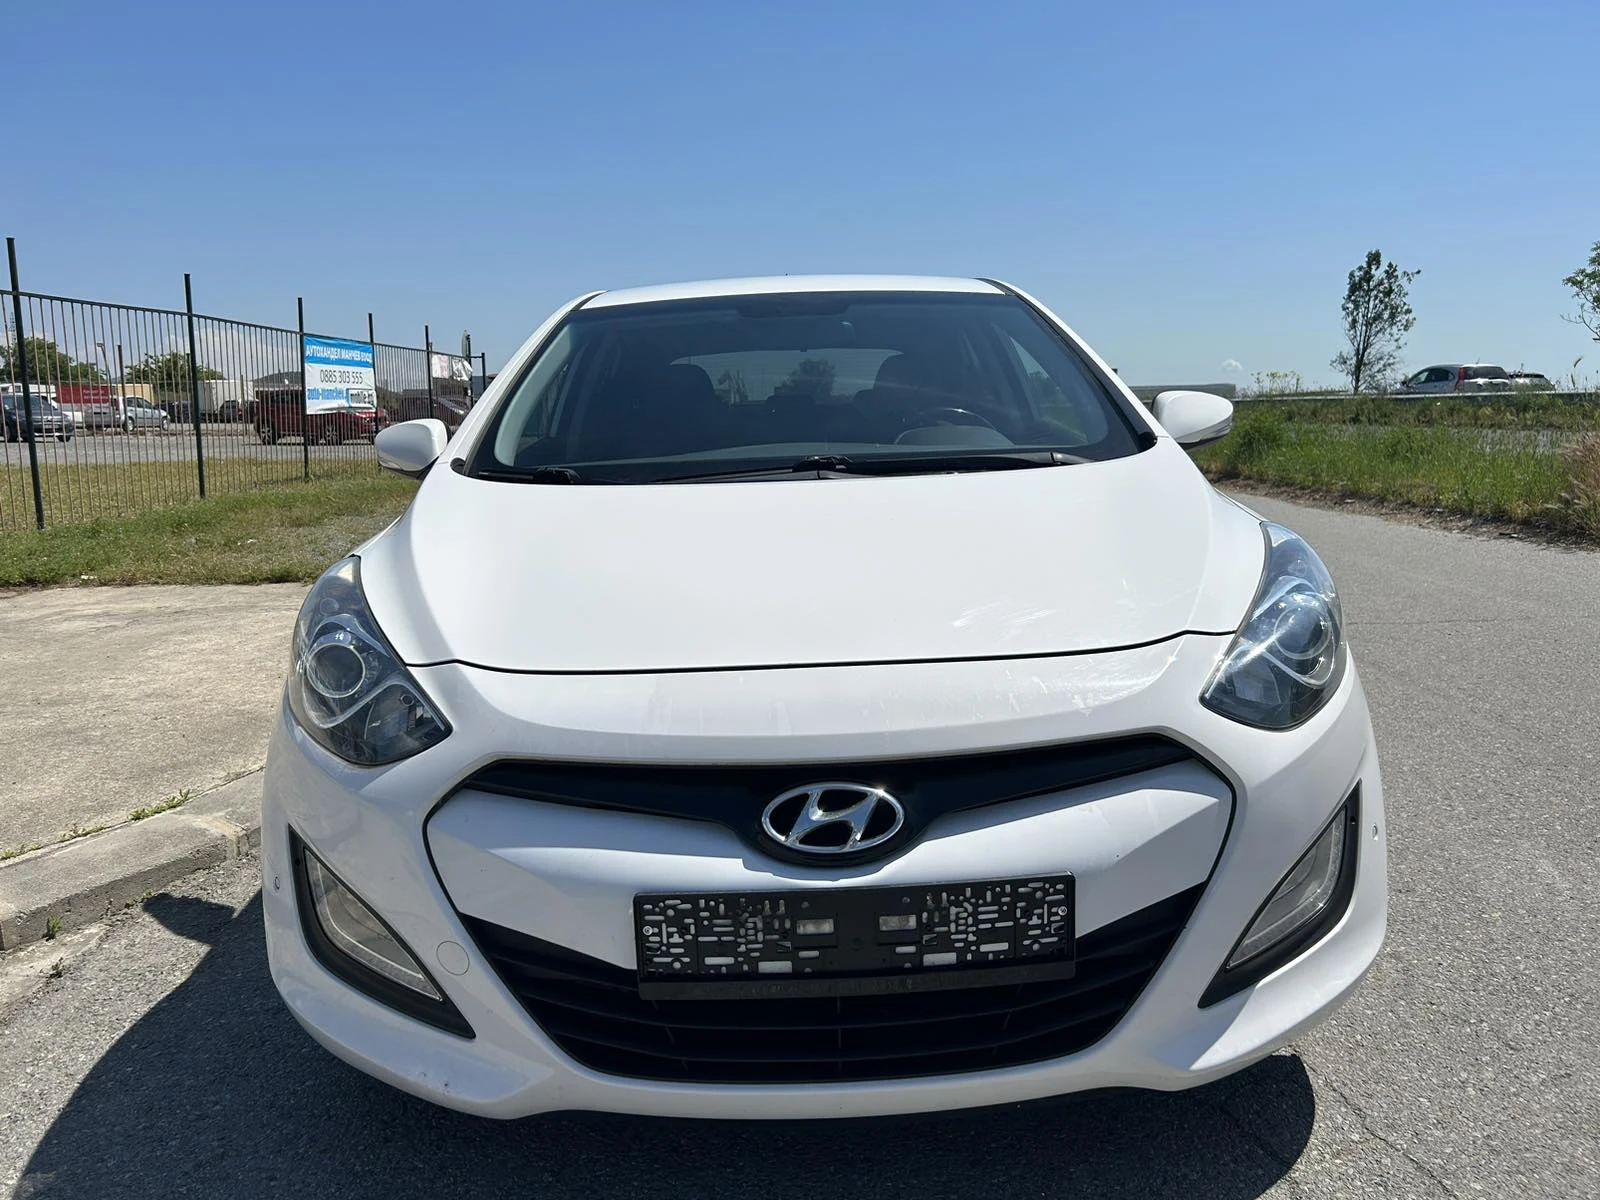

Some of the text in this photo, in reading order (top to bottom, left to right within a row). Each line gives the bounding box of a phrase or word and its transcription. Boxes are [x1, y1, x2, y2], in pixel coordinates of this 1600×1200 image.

[320, 369, 363, 384] 0885 303 555
